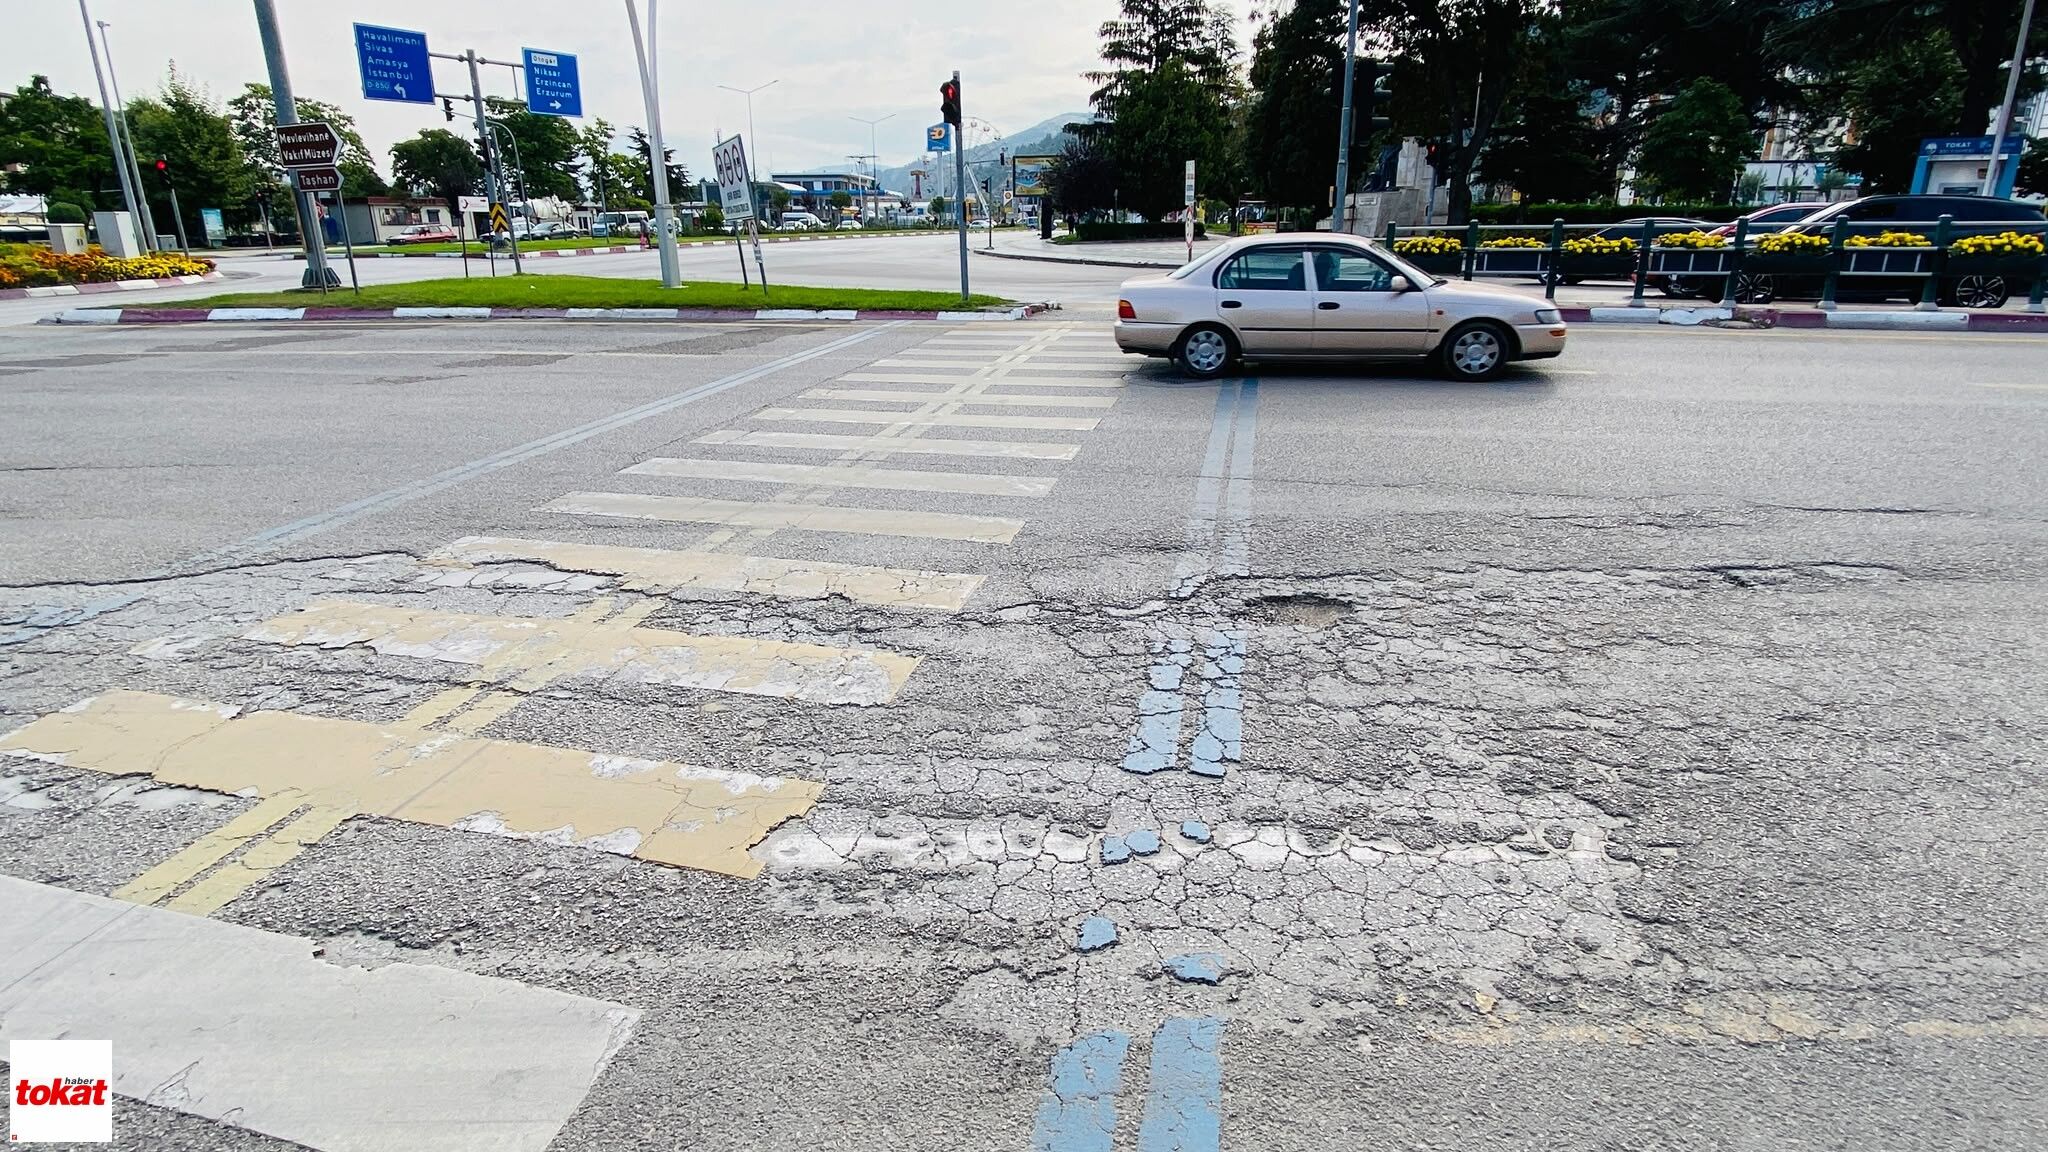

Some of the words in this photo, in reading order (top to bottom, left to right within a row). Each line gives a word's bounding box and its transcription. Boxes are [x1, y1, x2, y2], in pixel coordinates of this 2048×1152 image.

[365, 42, 393, 53] Sivas
[367, 56, 408, 69] Amasya
[534, 67, 560, 77] Niksar
[535, 77, 572, 88] Erzincan
[536, 88, 572, 98] Erzurum
[279, 132, 329, 144] Mevlevihane
[300, 174, 334, 186] Taşhan
